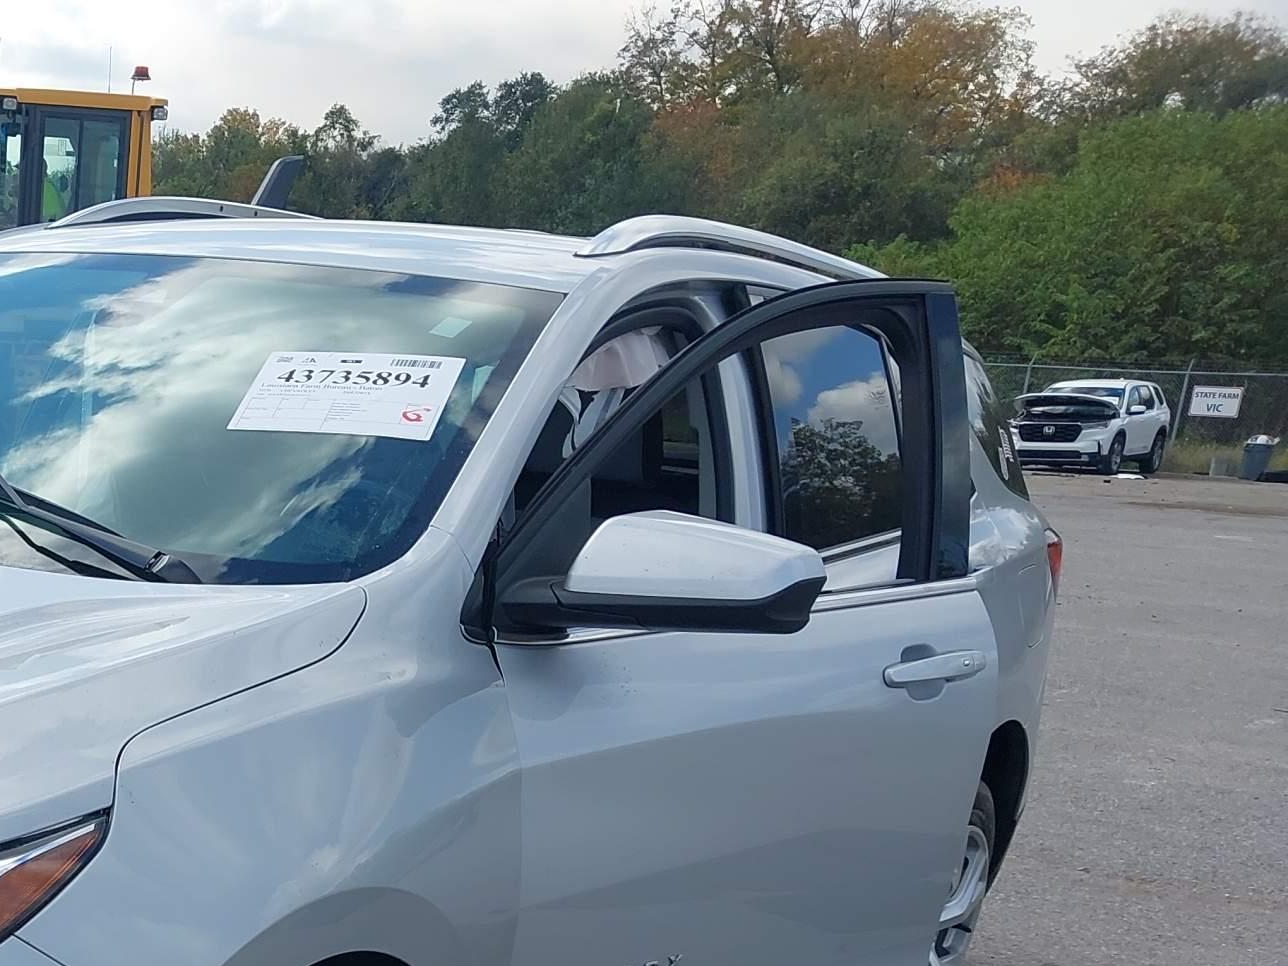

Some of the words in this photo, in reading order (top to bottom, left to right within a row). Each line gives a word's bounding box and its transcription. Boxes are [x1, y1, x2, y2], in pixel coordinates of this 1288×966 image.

[277, 369, 431, 388] 43735894
[1194, 391, 1217, 399] STATE
[1218, 391, 1239, 400] FARM
[1206, 403, 1223, 413] VIC
